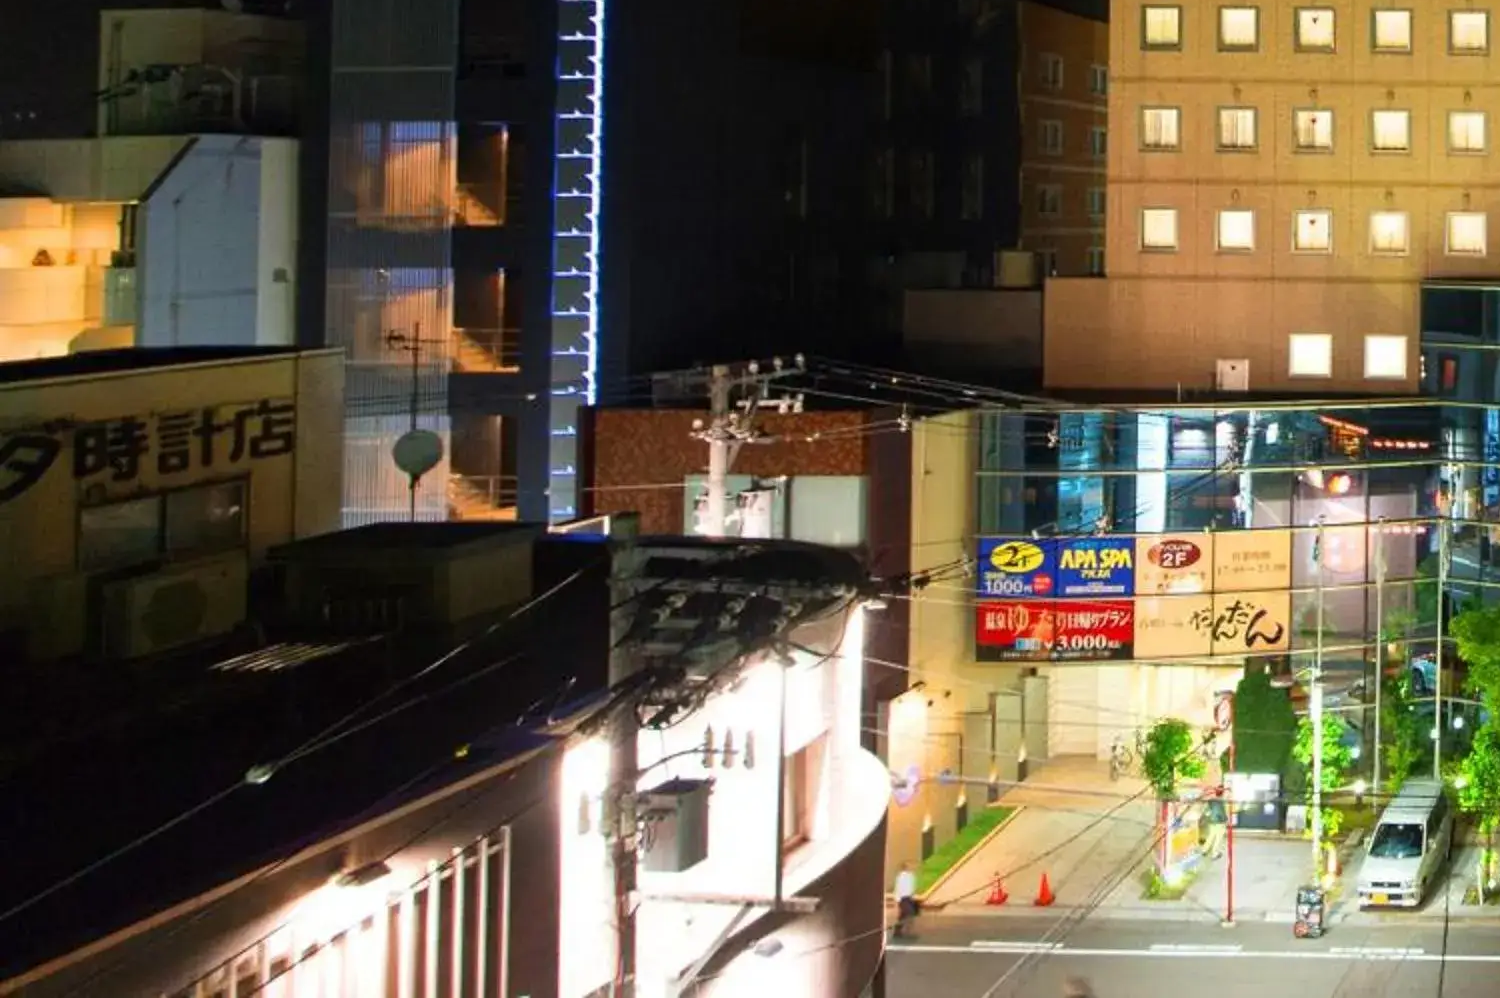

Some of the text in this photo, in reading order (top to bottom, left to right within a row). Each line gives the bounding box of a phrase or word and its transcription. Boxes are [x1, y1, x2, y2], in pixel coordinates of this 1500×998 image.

[1059, 548, 1132, 569] APA SPA
[1162, 551, 1187, 567] 2F
